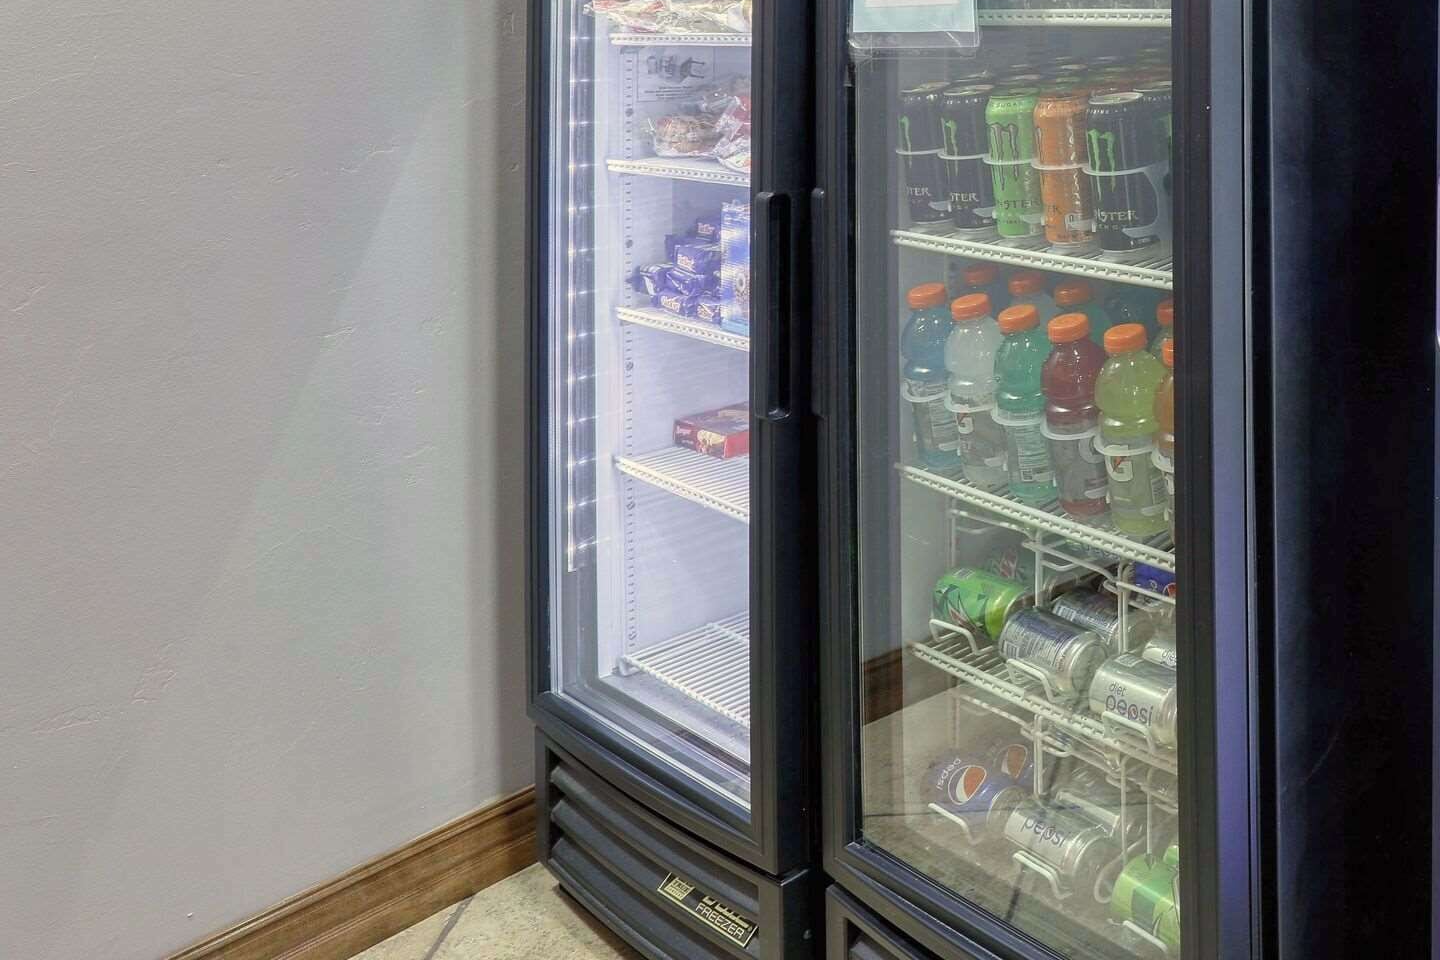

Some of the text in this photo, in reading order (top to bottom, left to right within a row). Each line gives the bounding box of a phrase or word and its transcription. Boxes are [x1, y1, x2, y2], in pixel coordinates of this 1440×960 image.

[1110, 681, 1127, 696] diet
[1105, 695, 1153, 727] pepsi
[1021, 819, 1072, 847] pepsi
[695, 902, 745, 939] FREEZER
